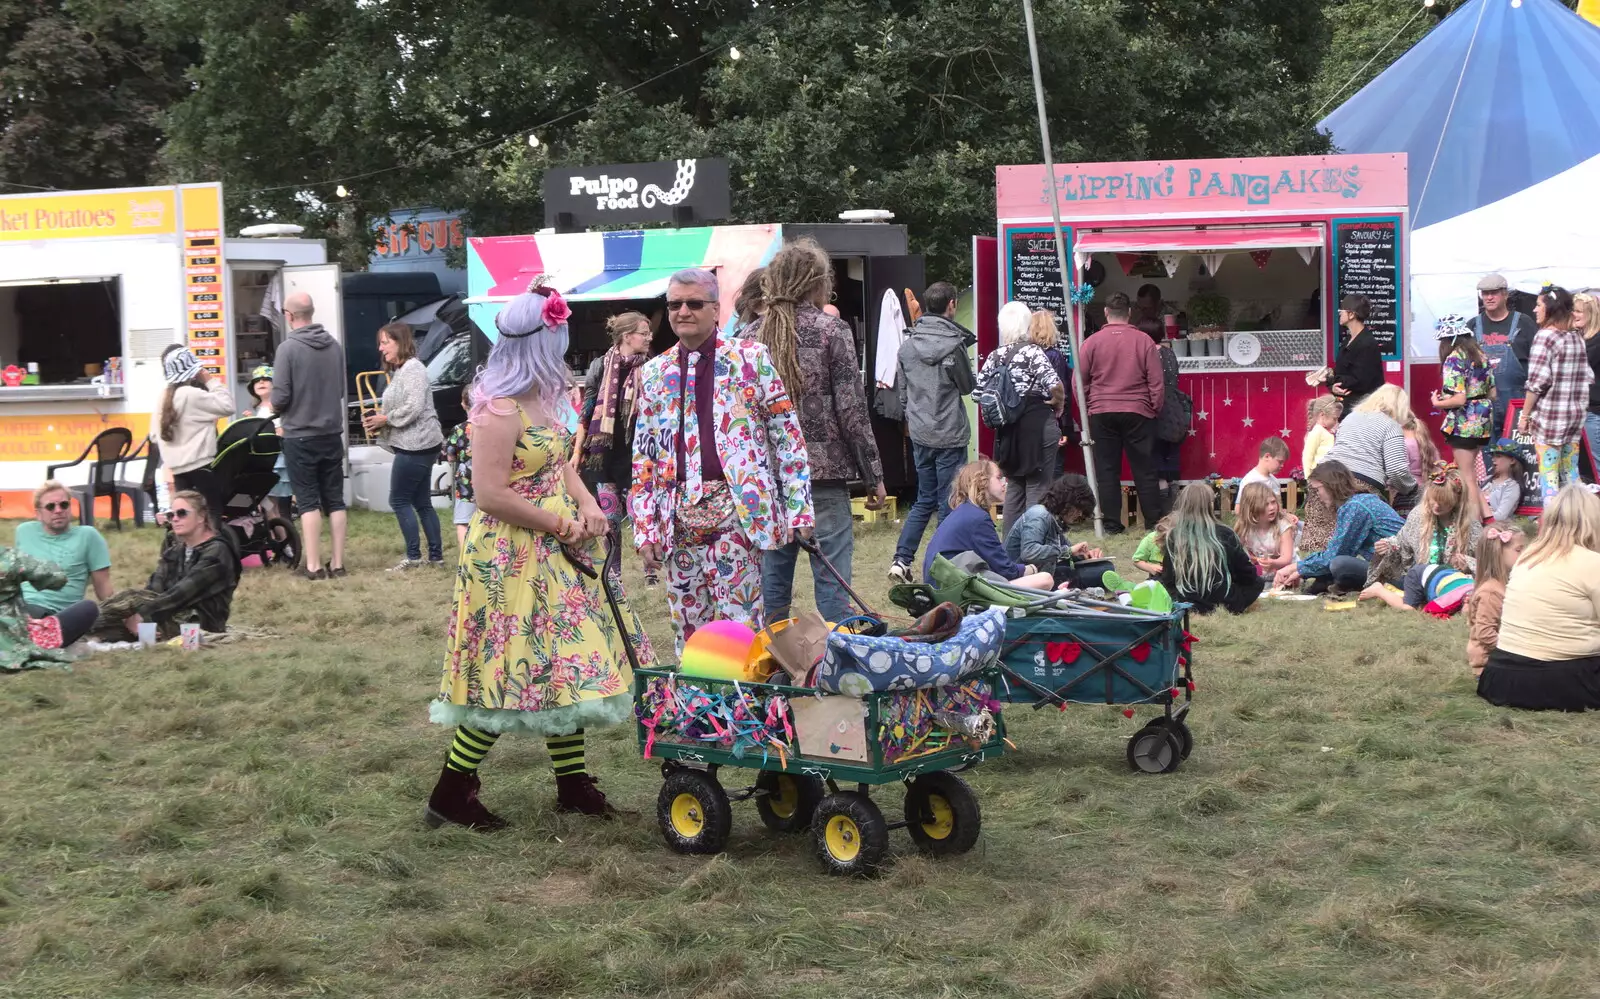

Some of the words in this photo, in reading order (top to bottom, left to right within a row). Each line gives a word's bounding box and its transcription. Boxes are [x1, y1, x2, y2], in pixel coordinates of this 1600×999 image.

[569, 174, 638, 198] Pulpo
[1188, 165, 1363, 204] PANCAKES
[596, 193, 639, 210] Food
[34, 208, 116, 230] Potatoes
[1350, 230, 1381, 240] SAVOURY
[1027, 239, 1057, 250] SWEET
[718, 436, 746, 450] PEACE
